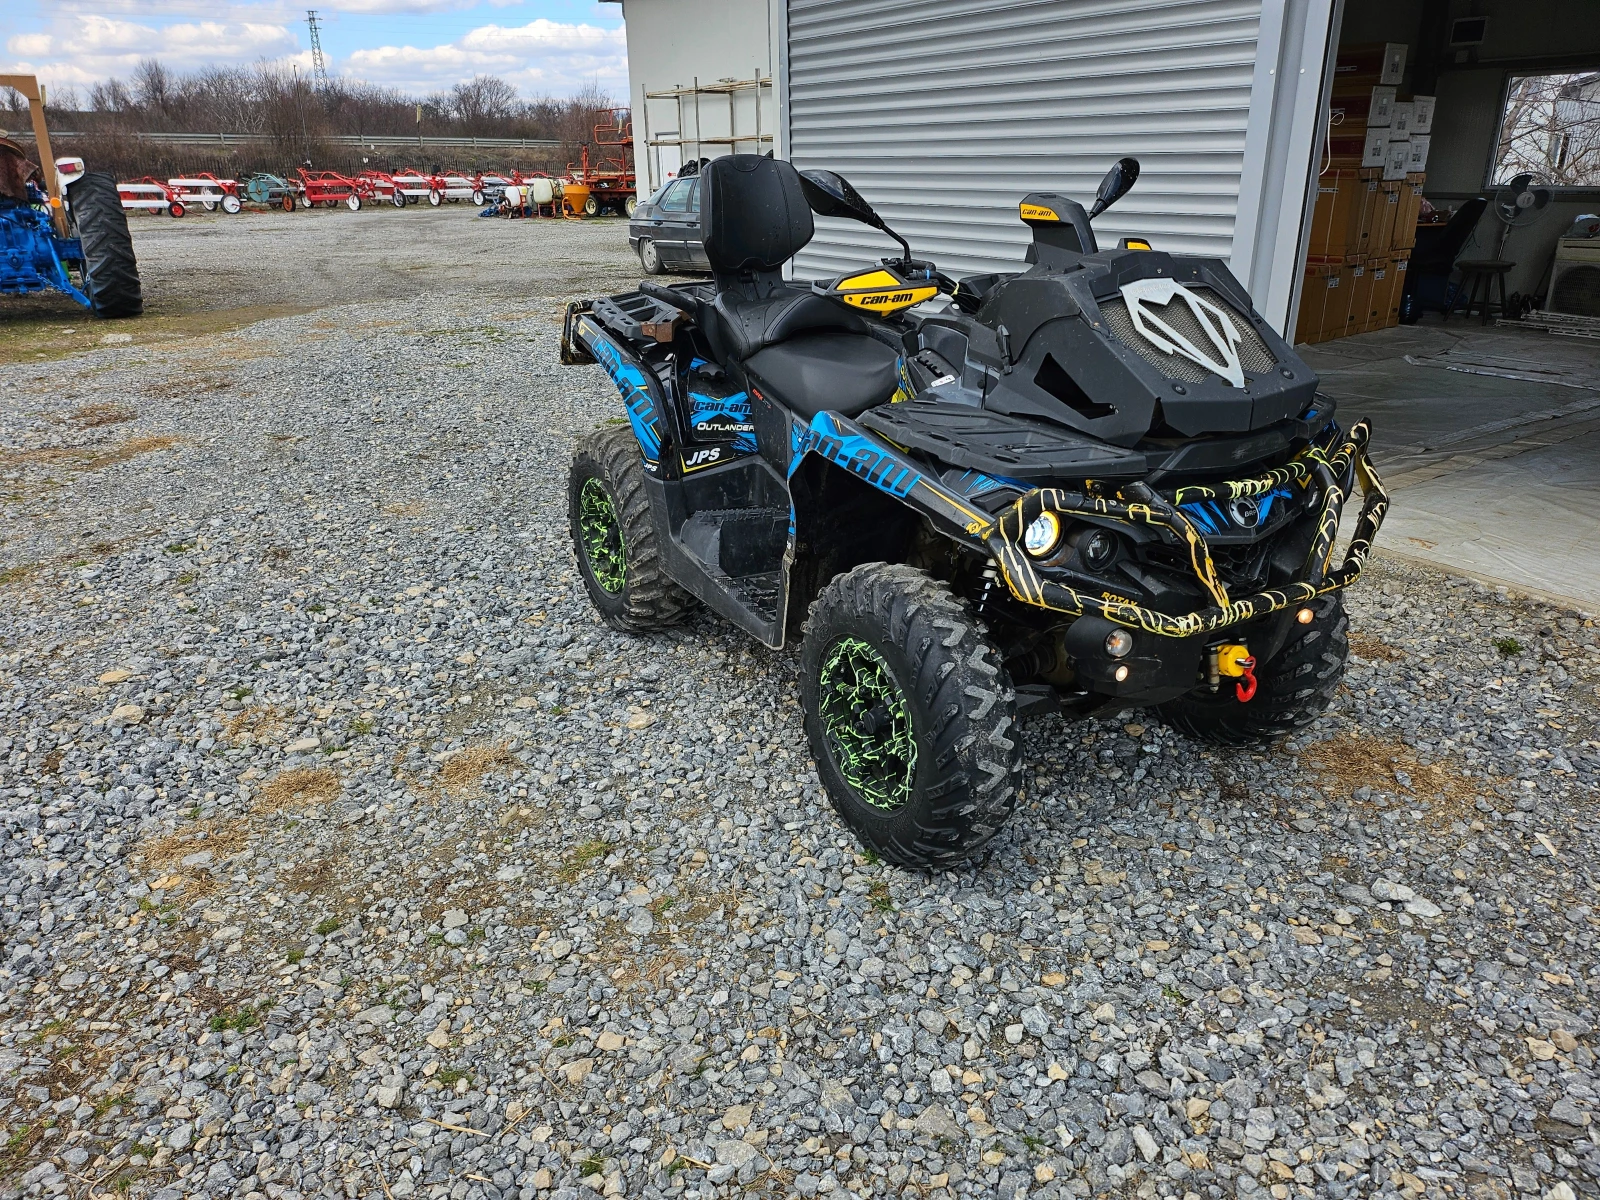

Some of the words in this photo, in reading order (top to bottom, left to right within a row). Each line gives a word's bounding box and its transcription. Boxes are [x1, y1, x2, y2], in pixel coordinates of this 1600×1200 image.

[1022, 209, 1052, 217] can-am
[860, 293, 913, 305] can-am
[592, 334, 659, 425] can-am
[693, 401, 752, 413] can-am
[697, 422, 755, 432] OUTLANDER
[685, 448, 721, 465] JPS
[644, 462, 658, 472] JPS
[801, 430, 920, 497] an-am
[1244, 509, 1257, 518] BRP
[1101, 591, 1138, 607] ROTAX
